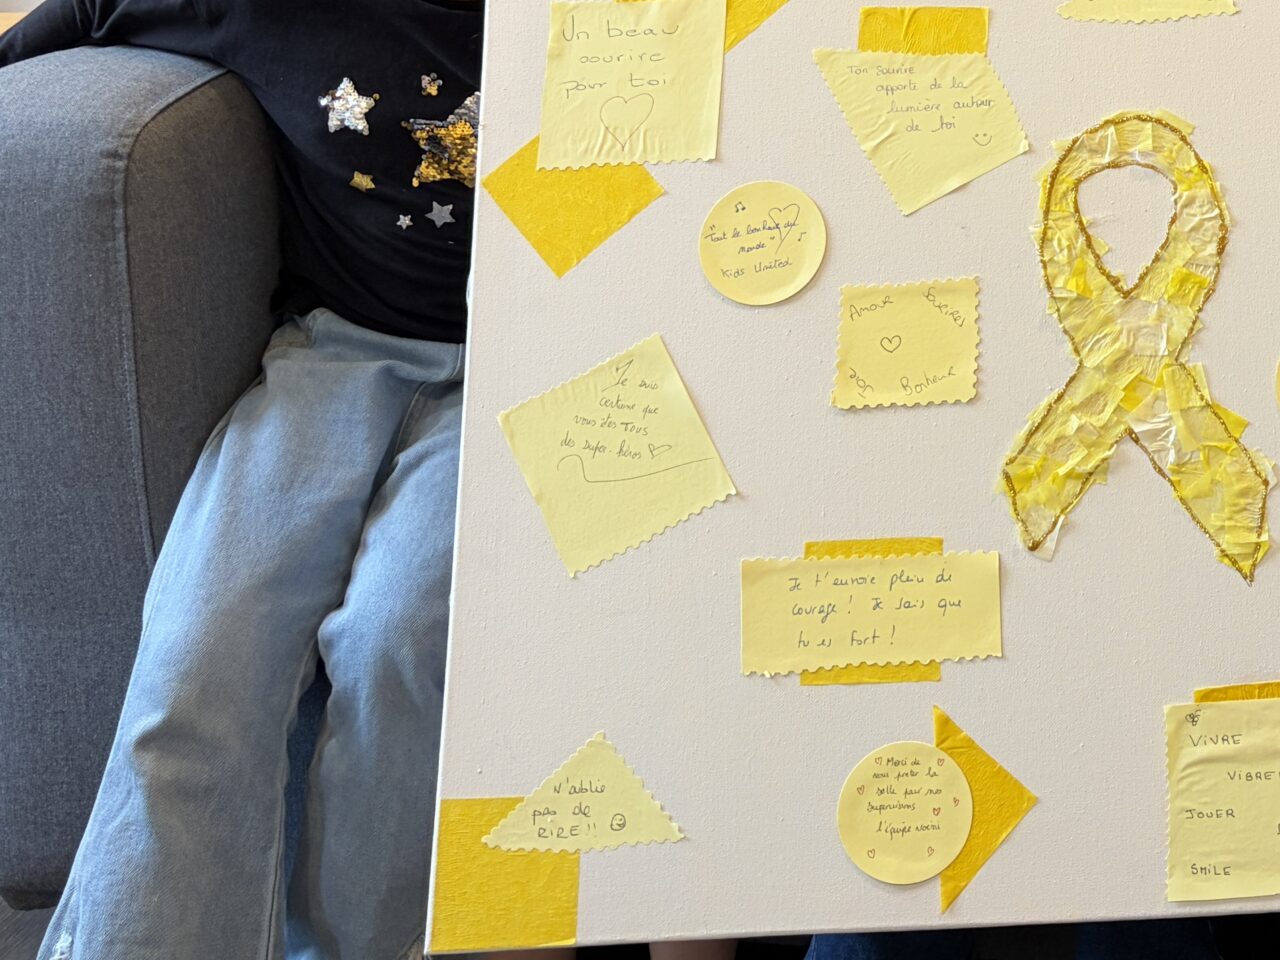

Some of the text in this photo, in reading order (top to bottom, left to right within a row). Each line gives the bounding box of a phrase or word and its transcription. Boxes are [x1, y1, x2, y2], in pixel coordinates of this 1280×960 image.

[562, 14, 679, 42] Un beau
[628, 72, 667, 88] toi
[847, 65, 868, 75] Ton
[875, 76, 968, 96] apporte de la
[953, 95, 996, 110] autour
[905, 115, 957, 133] de toi
[788, 577, 803, 591] Je
[889, 569, 925, 591] plein
[935, 567, 953, 584] de
[871, 597, 884, 611] Je
[894, 597, 926, 611] sais
[937, 597, 962, 617] que
[797, 630, 810, 649] tu
[849, 627, 881, 647] fort
[531, 801, 592, 826] pas de
[1184, 808, 1236, 820] JOUER
